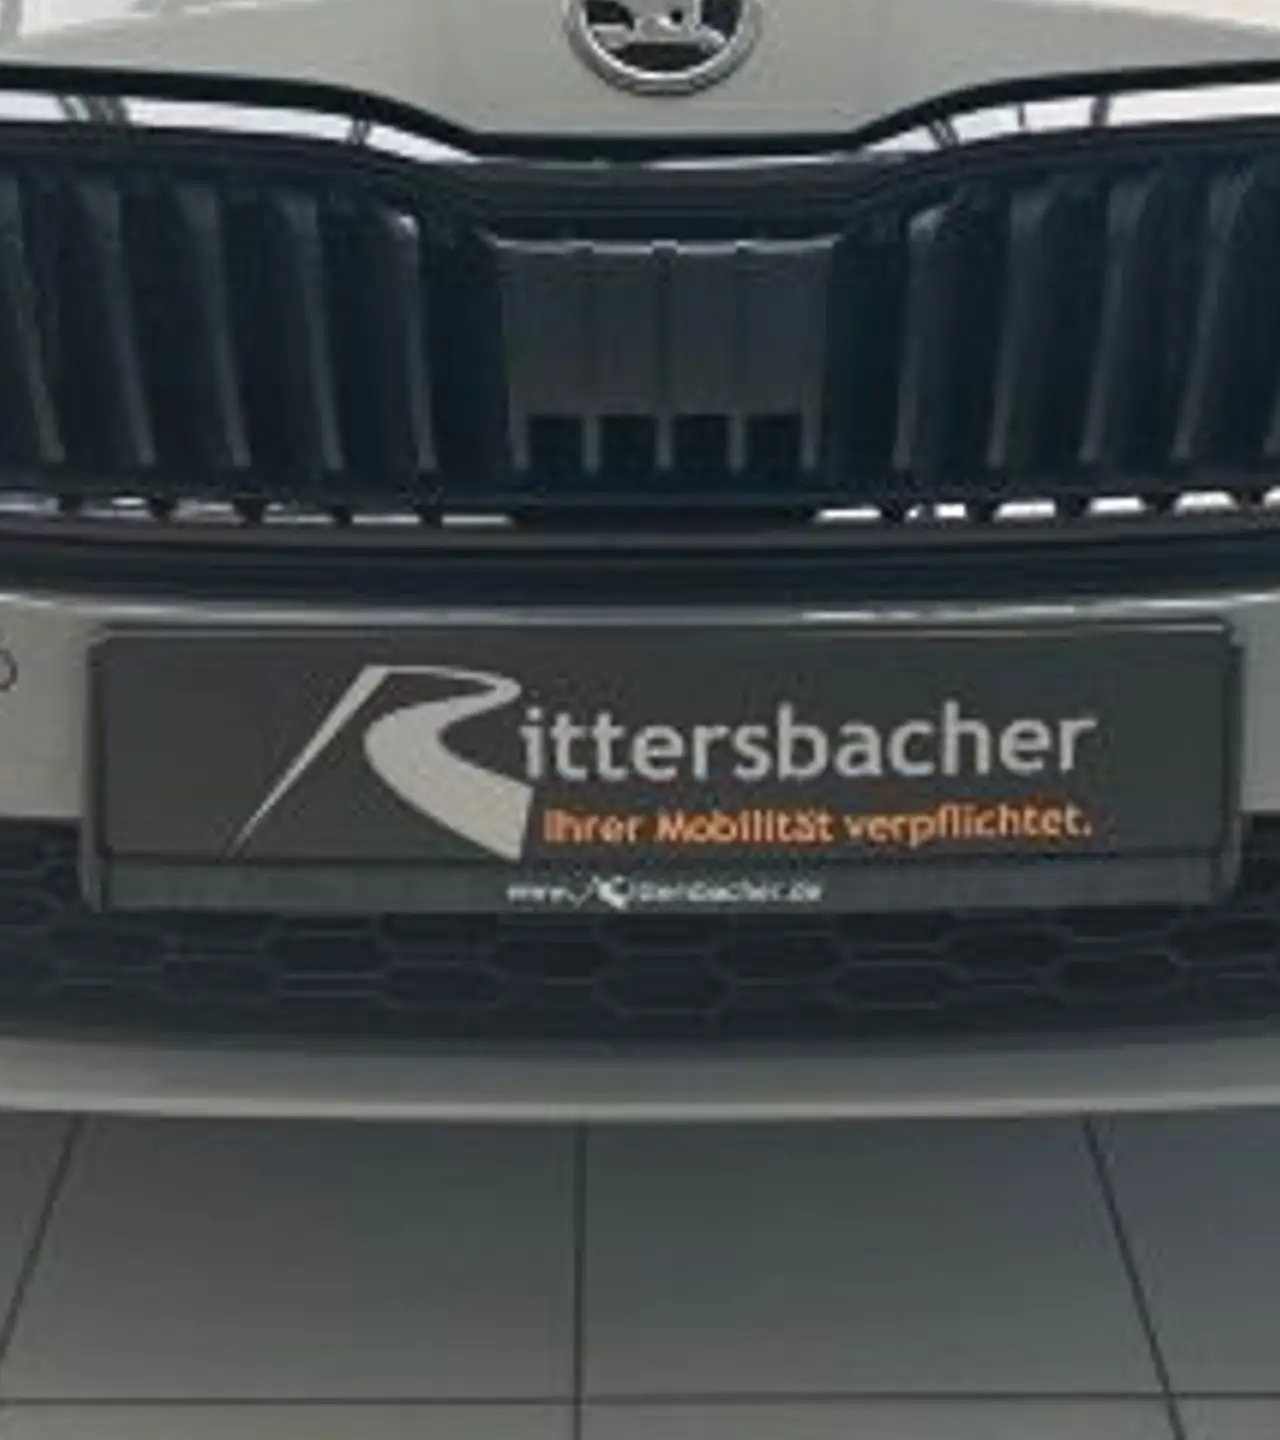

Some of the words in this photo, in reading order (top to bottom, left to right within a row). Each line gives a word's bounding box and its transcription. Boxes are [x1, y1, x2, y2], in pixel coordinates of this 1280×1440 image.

[543, 807, 641, 844] Ihrer
[656, 806, 834, 844] Mobilität
[844, 802, 1093, 849] verpflichtet.
